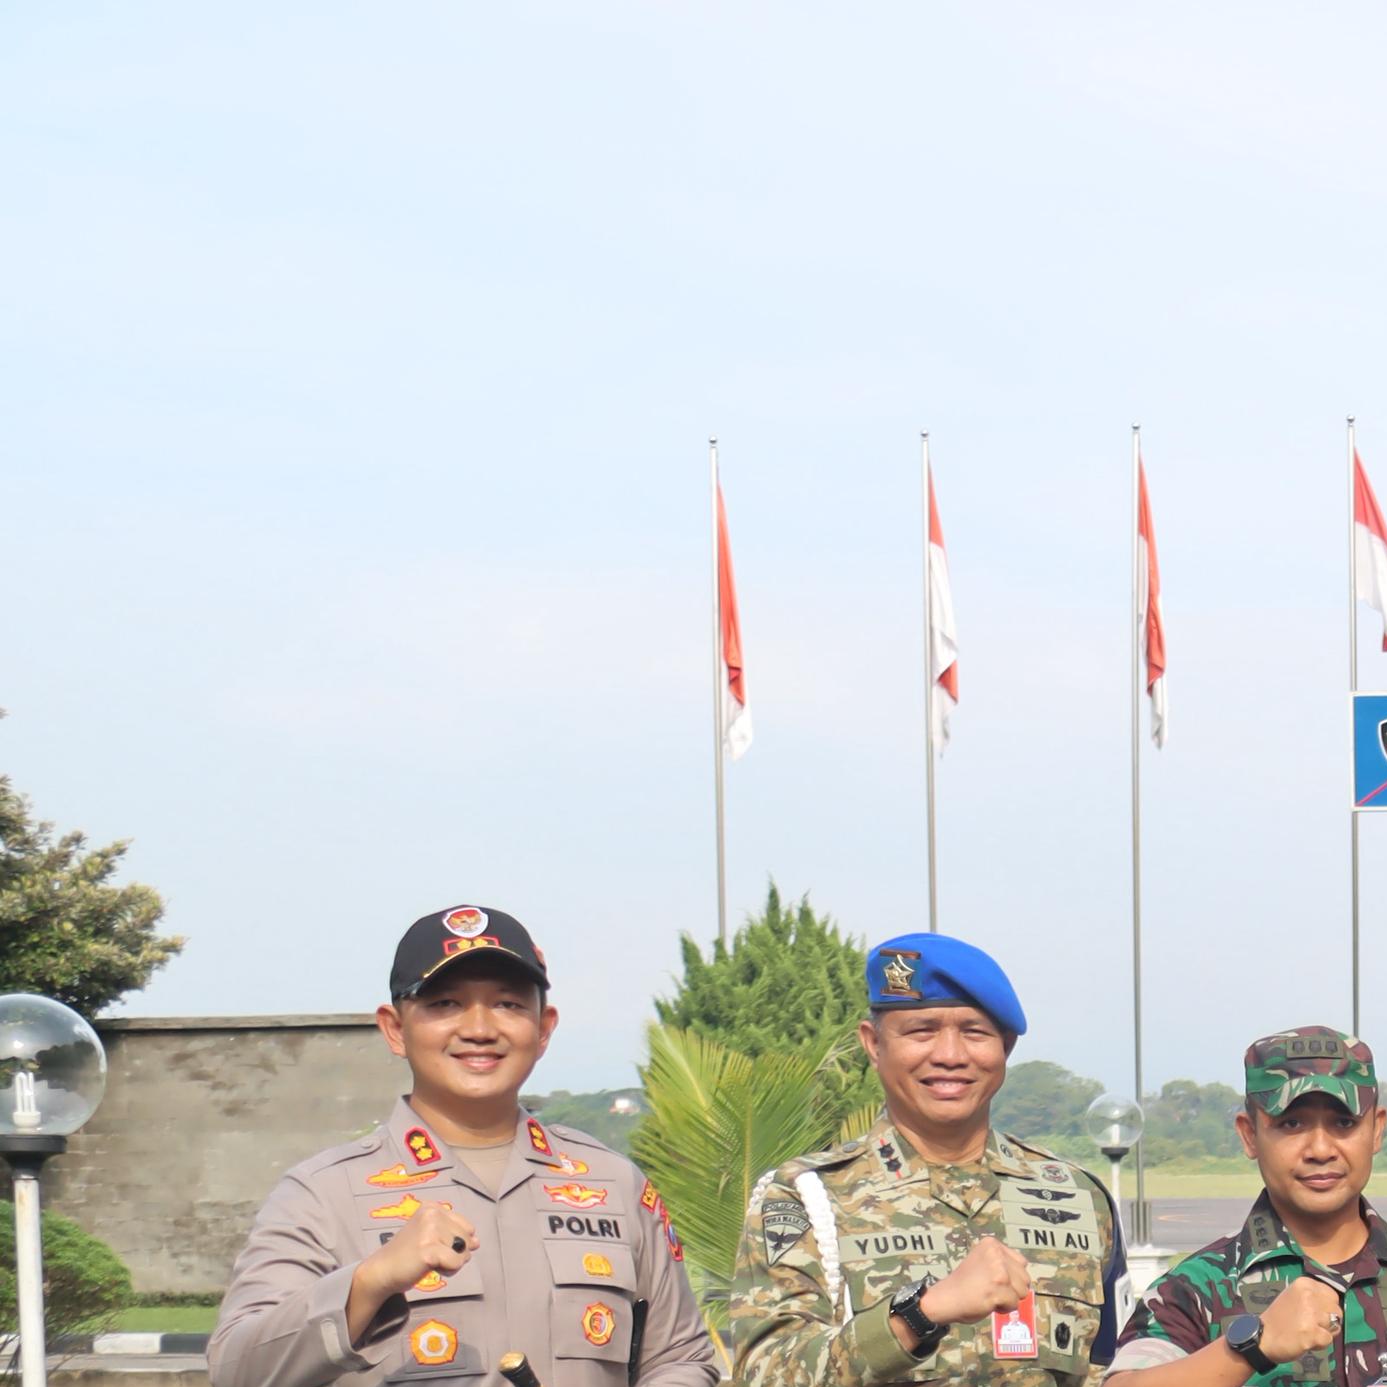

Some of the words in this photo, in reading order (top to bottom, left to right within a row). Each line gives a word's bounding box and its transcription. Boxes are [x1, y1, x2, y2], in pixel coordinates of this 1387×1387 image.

[548, 1215, 621, 1239] POLRI
[855, 1234, 934, 1255] YUDHI
[1019, 1228, 1056, 1247] TNI
[1064, 1232, 1090, 1250] AU
